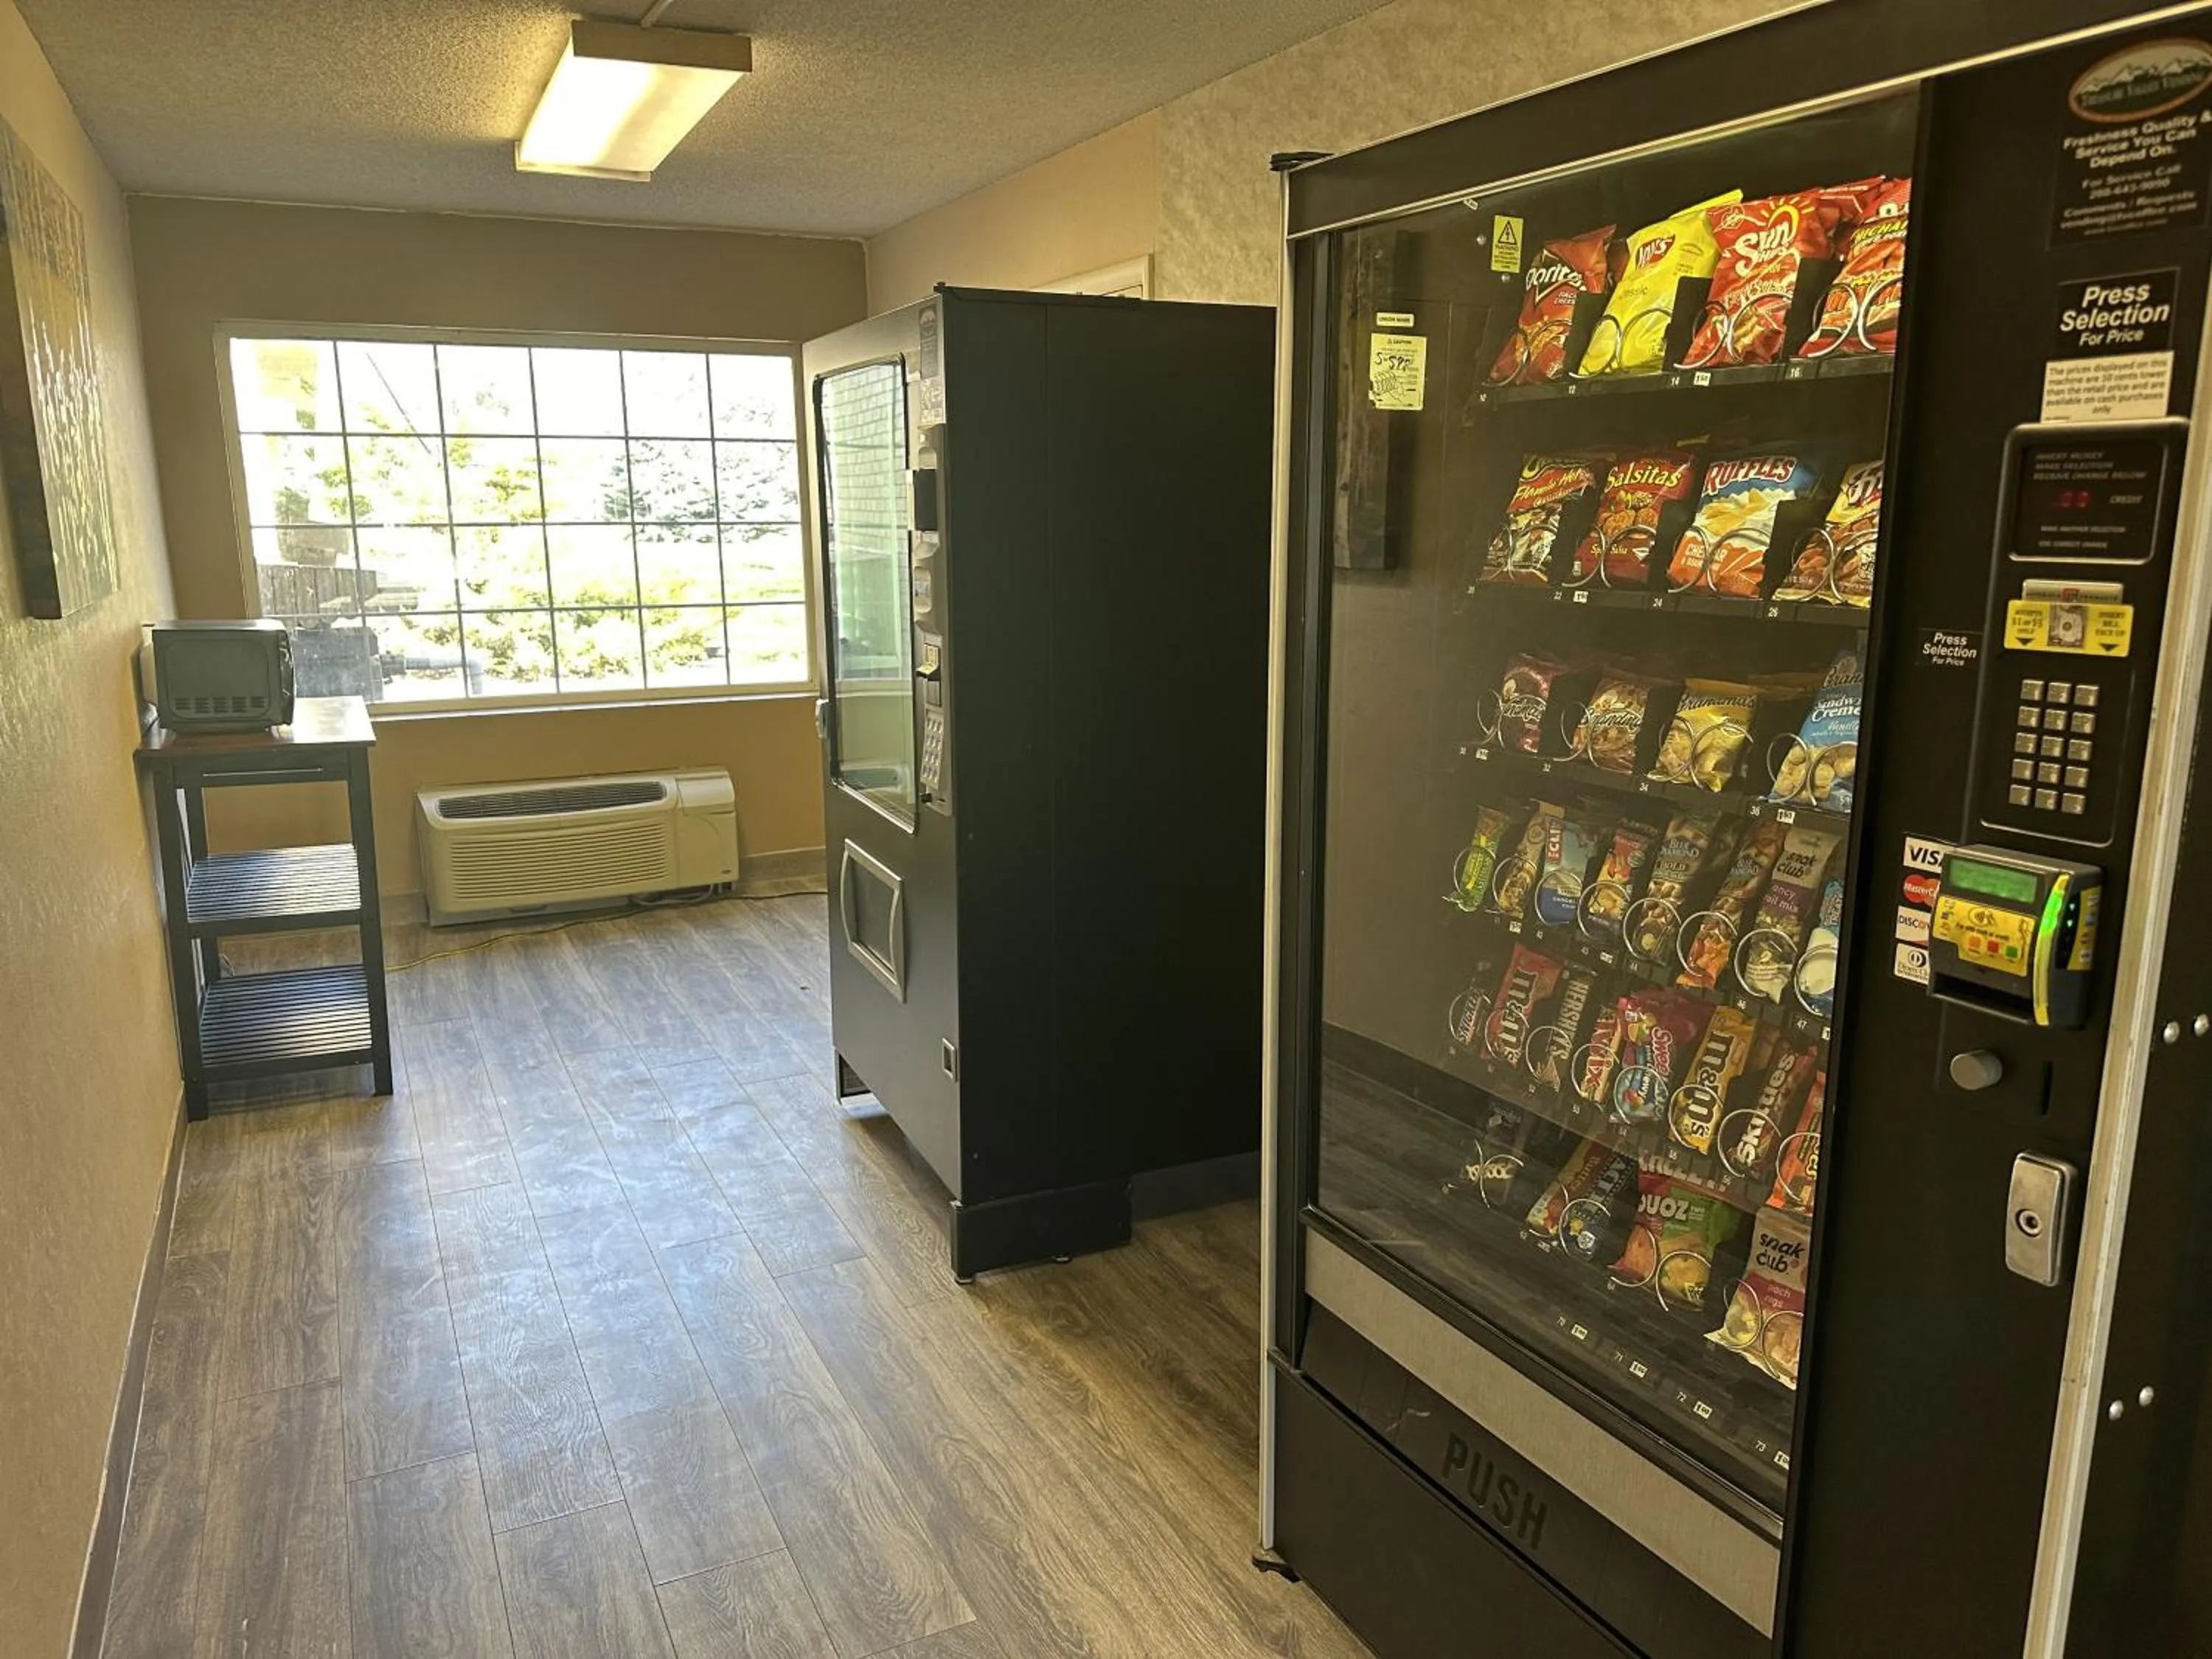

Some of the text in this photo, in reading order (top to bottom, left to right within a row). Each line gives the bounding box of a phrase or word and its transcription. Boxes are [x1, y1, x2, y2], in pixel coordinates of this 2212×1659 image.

[2063, 127, 2138, 150] Freshness
[2142, 116, 2197, 133] Quality
[2075, 128, 2197, 159] Service You Can
[2090, 149, 2146, 168] Depend
[2081, 283, 2151, 308] Press
[2059, 303, 2171, 333] Selection
[2079, 328, 2143, 347] For Price
[2049, 367, 2065, 375] The
[2066, 366, 2091, 376] prices
[2093, 361, 2135, 373] displayed
[2048, 377, 2083, 386] machine
[2114, 372, 2138, 380] cents
[2140, 370, 2166, 379] lower
[2047, 381, 2166, 396] than the retail price and are
[2046, 397, 2082, 407] available
[2097, 394, 2116, 403] cash
[2118, 392, 2164, 403] purchases
[2092, 406, 2112, 414] only
[1604, 463, 1682, 493] Salsitas
[1703, 456, 1798, 496] RUFFLES
[1653, 597, 1663, 608] 24
[1933, 632, 1968, 647] Press
[1922, 642, 1978, 660] Selection
[1932, 655, 1964, 667] For Price
[1812, 706, 1861, 722] Creme
[1910, 846, 1943, 867] VIS
[1777, 863, 1804, 878] club
[1772, 885, 1795, 900] ancy
[1904, 883, 1937, 898] MasterC
[1898, 914, 1931, 929] DISCOV
[1551, 979, 1590, 1061] HERSHEY'S
[1759, 1233, 1806, 1259] snak
[1677, 1391, 1686, 1402] 72
[1755, 1440, 1766, 1452] 73
[1443, 1431, 1548, 1549] PUSH
